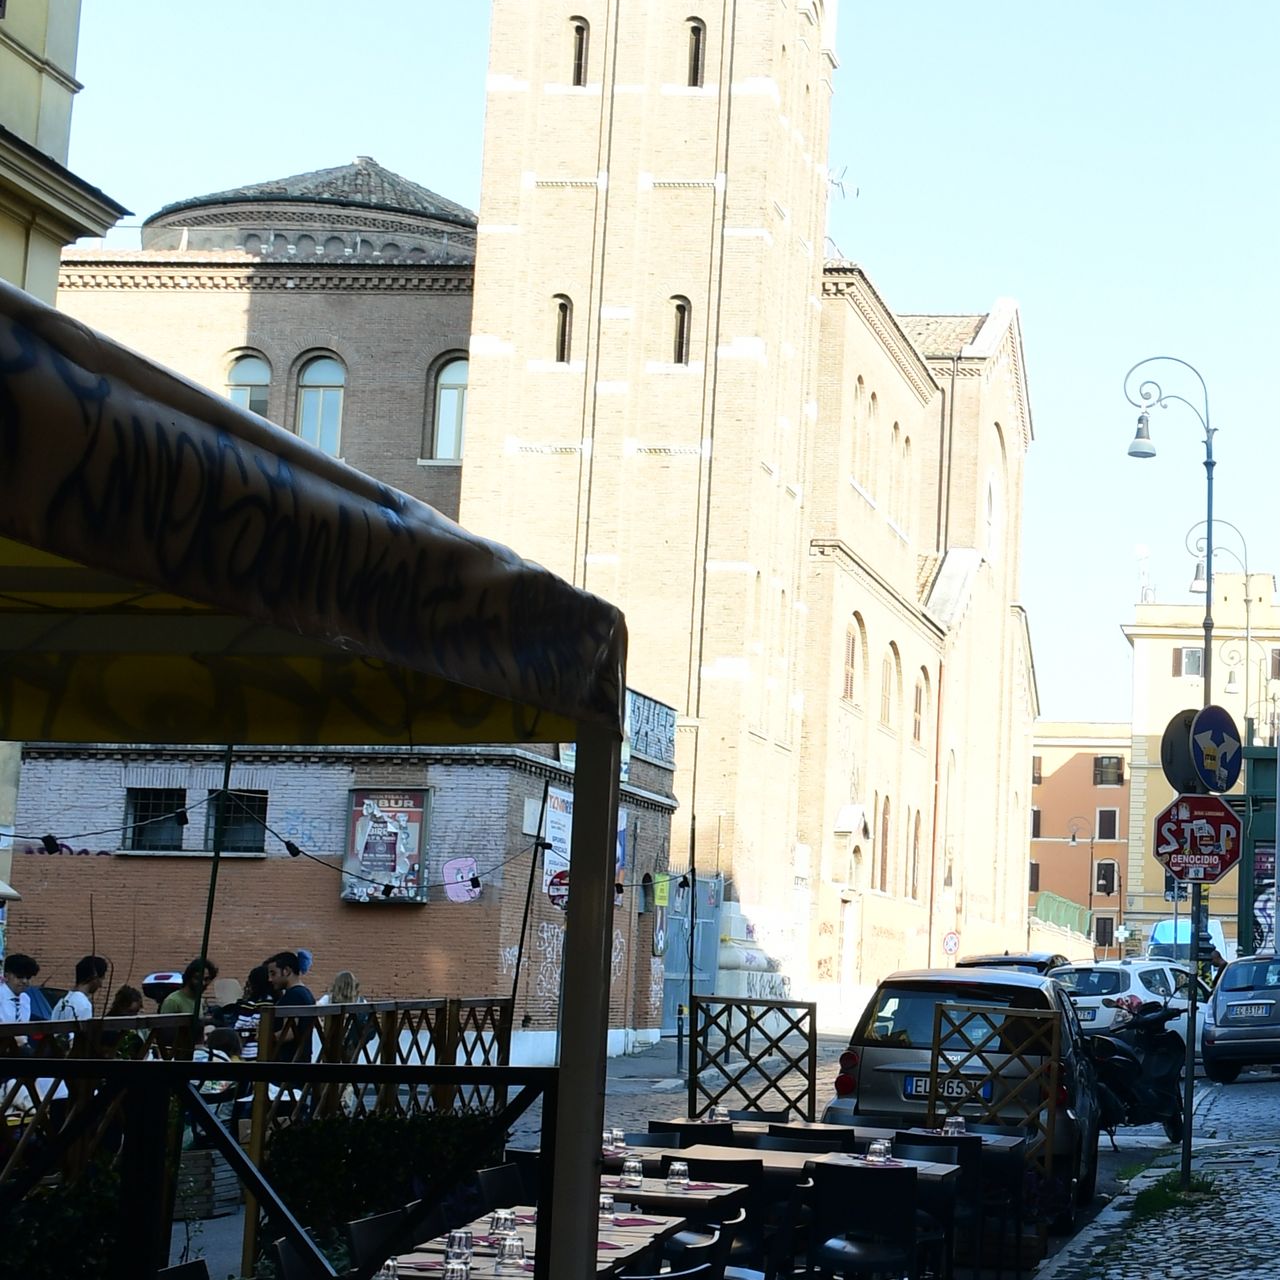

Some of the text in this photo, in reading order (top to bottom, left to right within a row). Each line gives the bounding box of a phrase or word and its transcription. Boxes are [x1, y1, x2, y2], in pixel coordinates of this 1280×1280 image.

[1157, 821, 1237, 856] STOP
[1171, 854, 1219, 864] GENOCIDIO
[915, 1079, 930, 1094] EL
